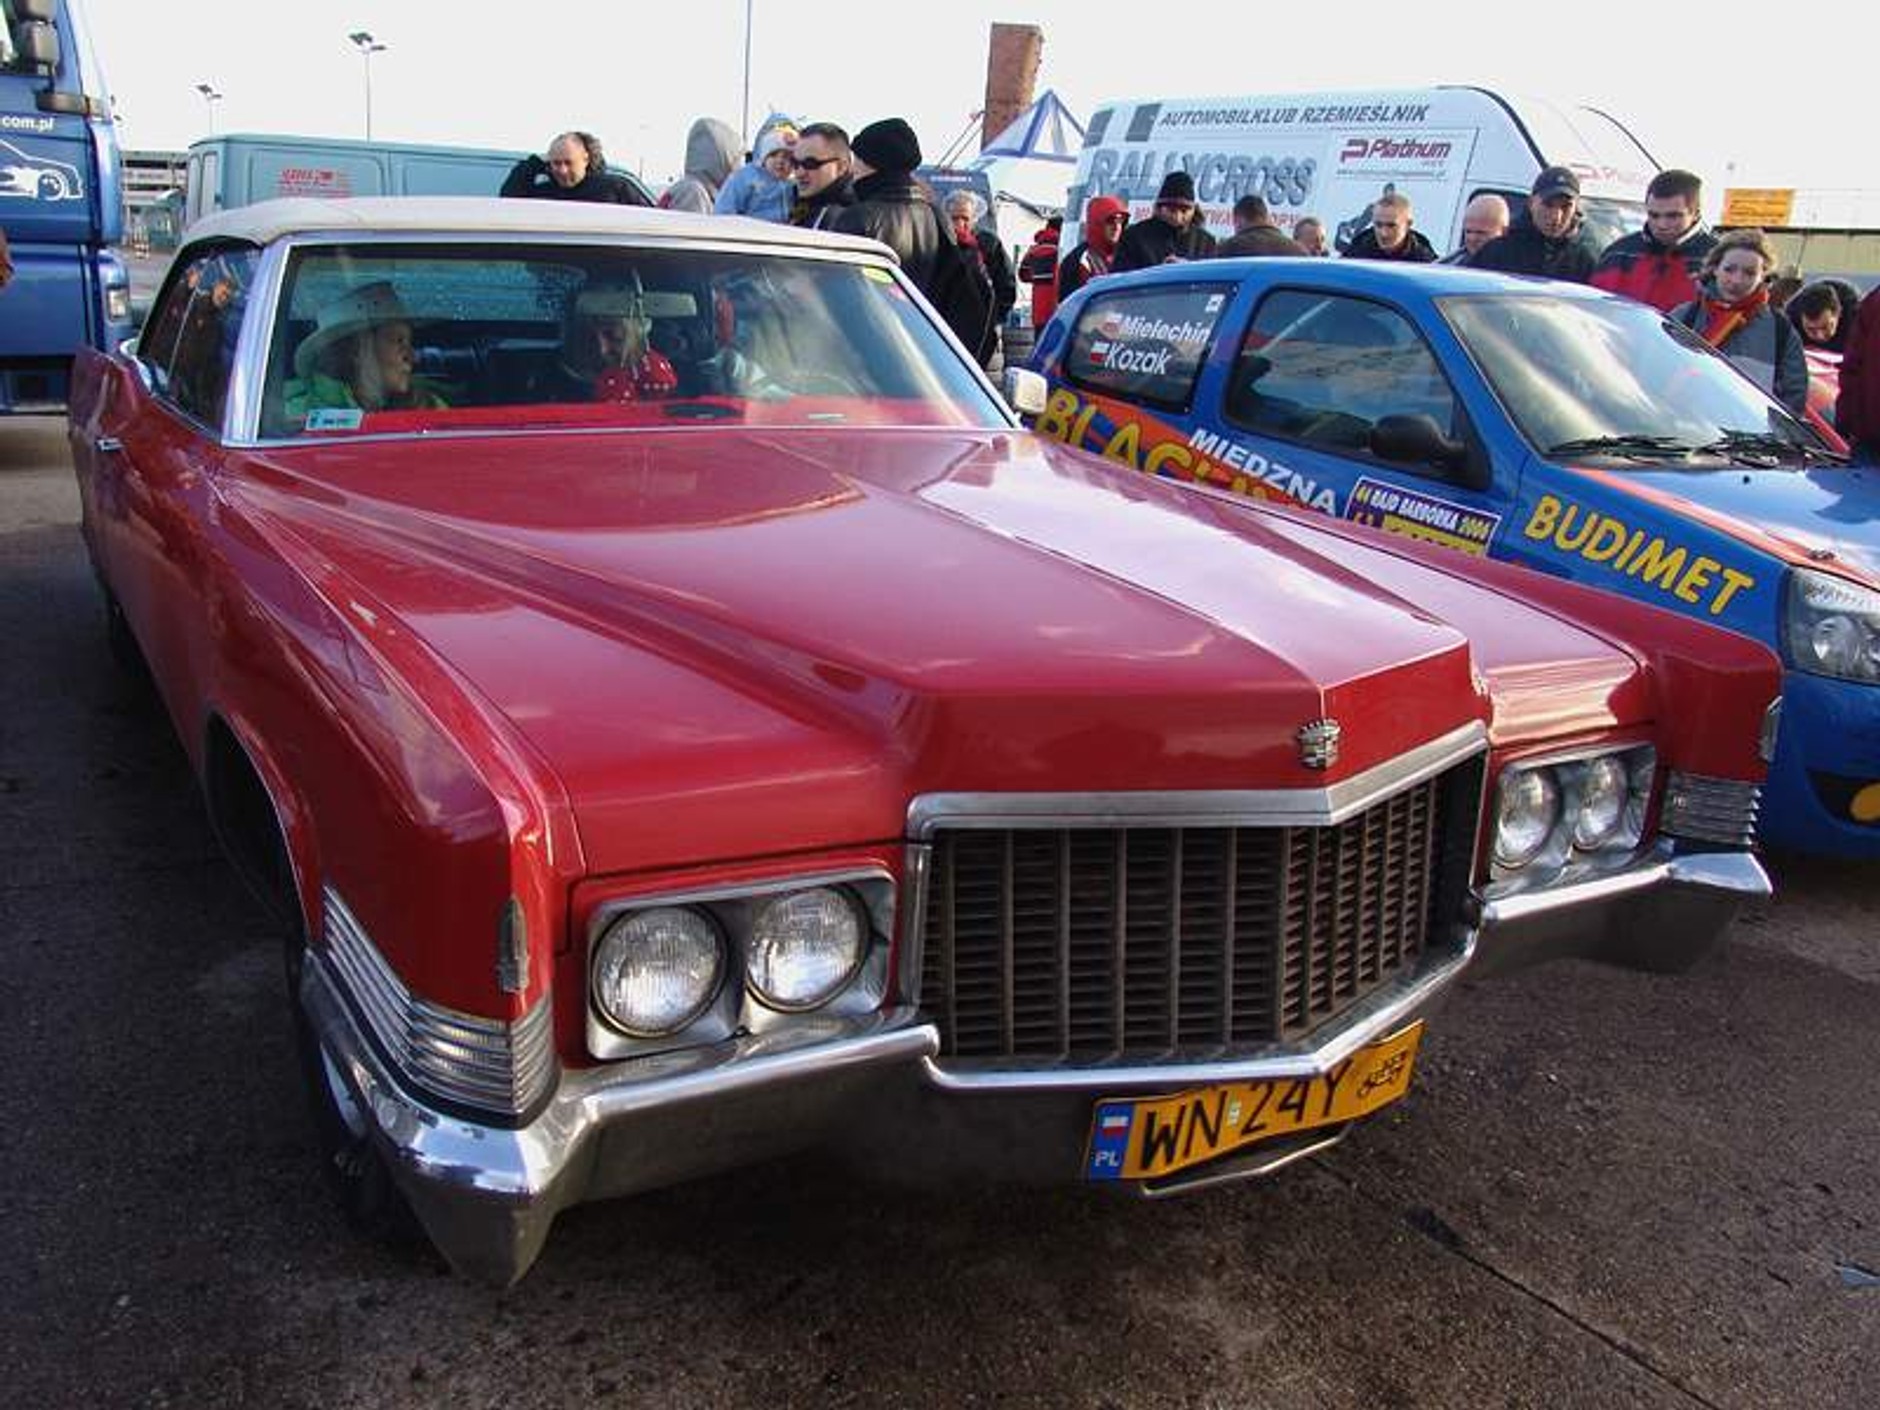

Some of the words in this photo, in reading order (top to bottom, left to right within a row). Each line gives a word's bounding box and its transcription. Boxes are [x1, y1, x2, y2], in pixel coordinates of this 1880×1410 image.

[1161, 108, 1298, 126] AUTOMOBILKLUB
[1368, 139, 1451, 158] Platinum
[1104, 341, 1172, 375] Kozak
[1188, 428, 1337, 518] MIEDZNA
[1523, 495, 1755, 616] BUDIMET
[1138, 1090, 1228, 1172] WN
[1240, 1060, 1354, 1136] 24Y
[1095, 1150, 1121, 1168] PL
